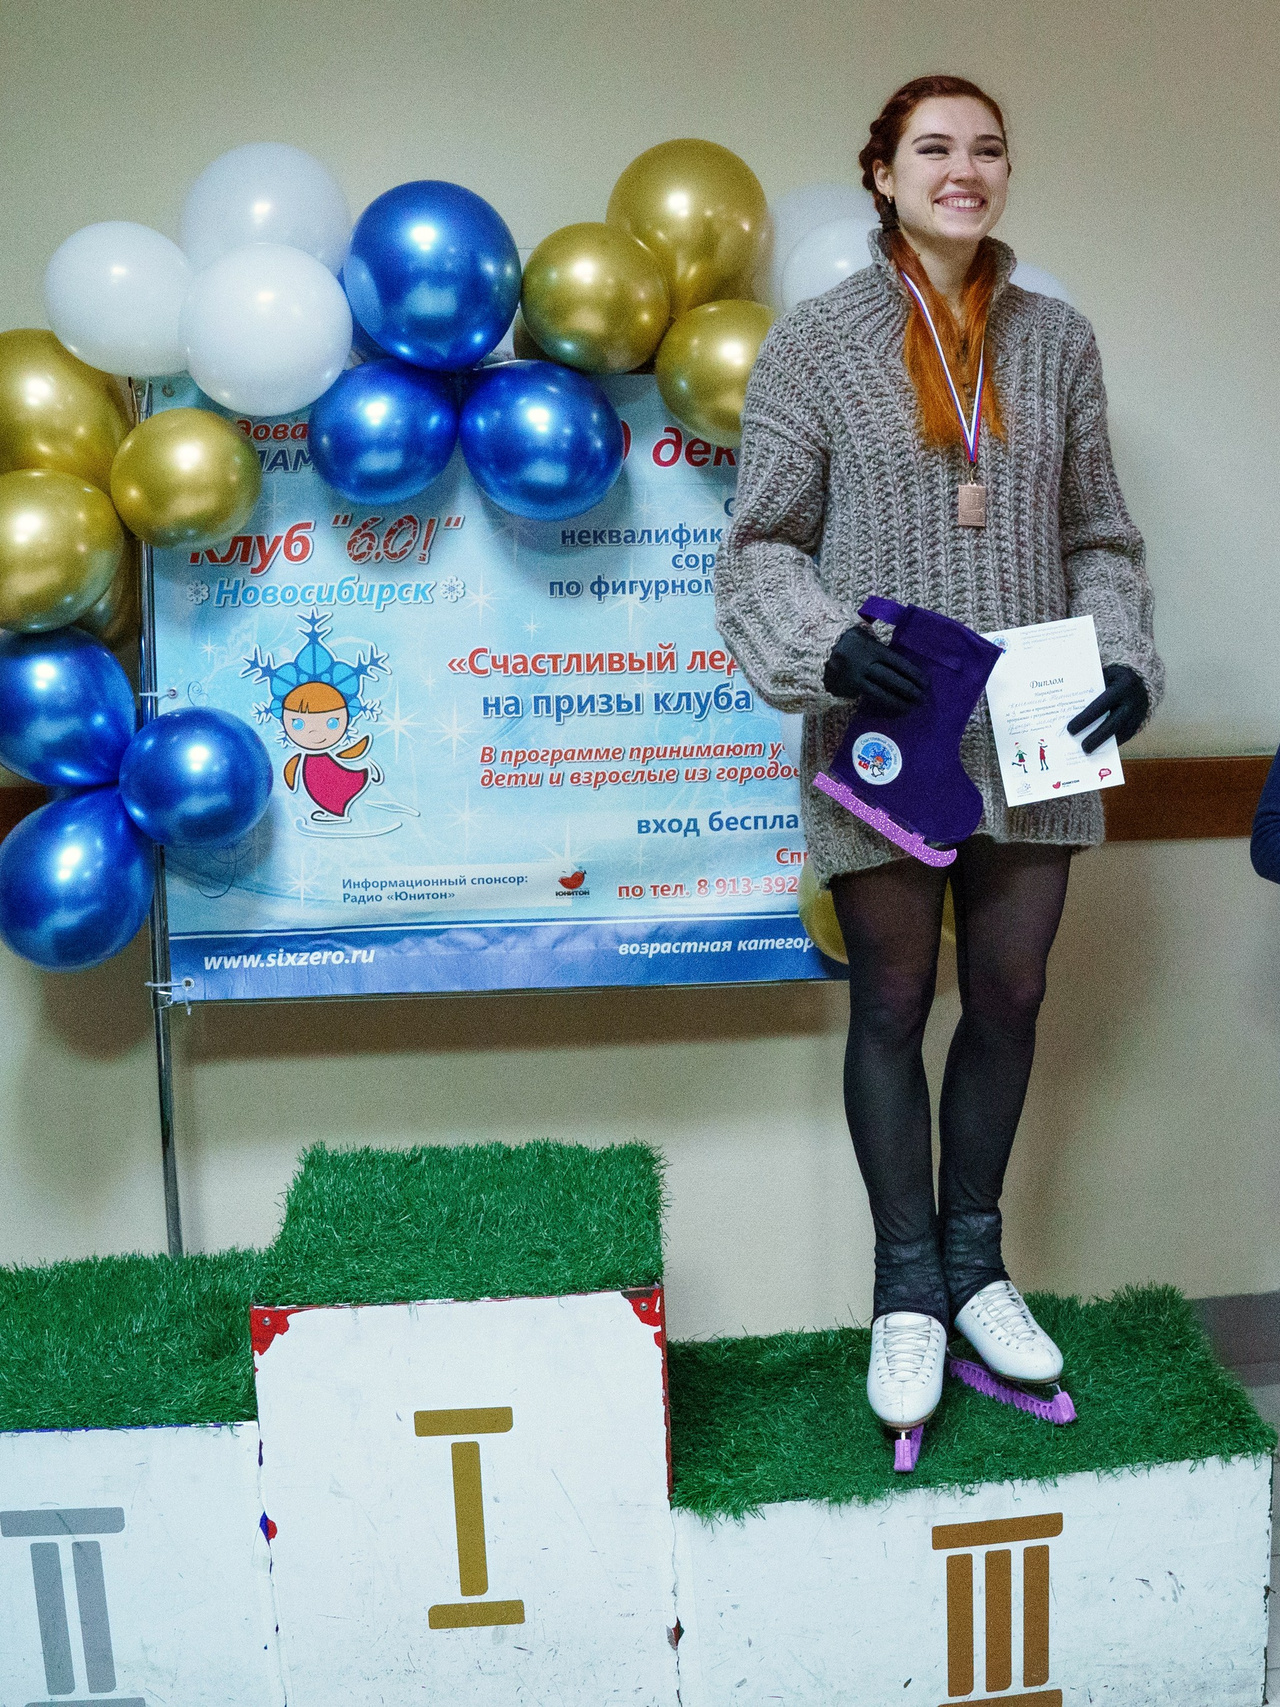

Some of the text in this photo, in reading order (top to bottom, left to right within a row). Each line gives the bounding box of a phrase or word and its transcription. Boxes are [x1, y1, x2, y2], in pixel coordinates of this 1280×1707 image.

[561, 522, 723, 550] неквалифик
[214, 575, 434, 612] Новосибирск
[549, 581, 582, 597] по
[447, 642, 677, 677] «Счастливый
[1029, 677, 1064, 689] Диплом
[482, 683, 752, 724] на призы клуба
[480, 747, 494, 765] В
[499, 744, 623, 768] программе
[628, 741, 763, 763] принимают
[480, 768, 541, 788] дети
[548, 771, 562, 786] и
[569, 766, 675, 789] взрослые
[683, 766, 709, 782] из
[636, 810, 799, 837] вход беспла
[342, 874, 529, 891] Информационный спонсор:
[617, 875, 799, 898] по тел. 8 913-392
[342, 890, 456, 905] Радио «Юнитон»
[618, 936, 815, 957] возрастная категор
[204, 947, 376, 970] www.sixzero.ru
